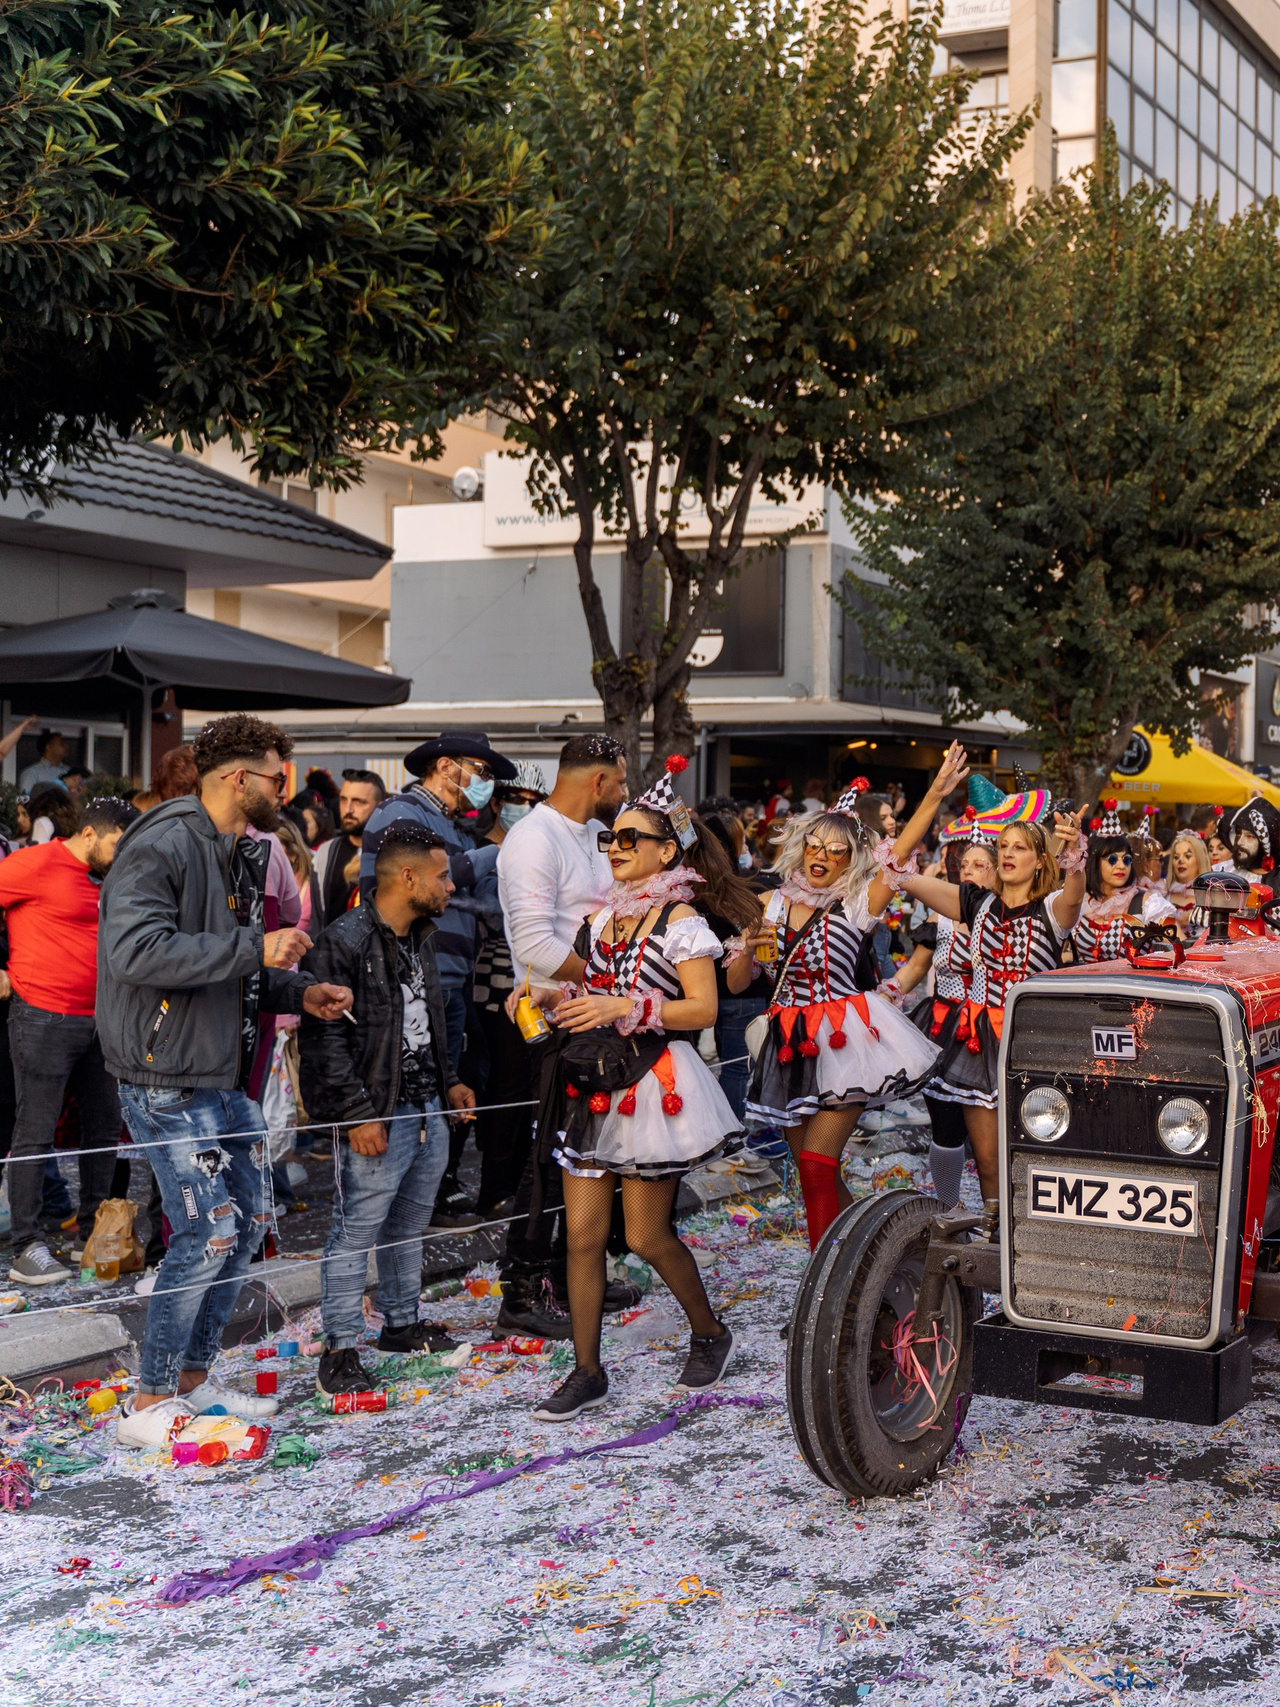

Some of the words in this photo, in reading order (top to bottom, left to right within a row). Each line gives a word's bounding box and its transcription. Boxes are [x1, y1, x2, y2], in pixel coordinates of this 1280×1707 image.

[1123, 780, 1161, 792] BEER
[1094, 1032, 1134, 1053] MF
[1032, 1174, 1109, 1219] EMZ
[1117, 1183, 1193, 1228] 325
